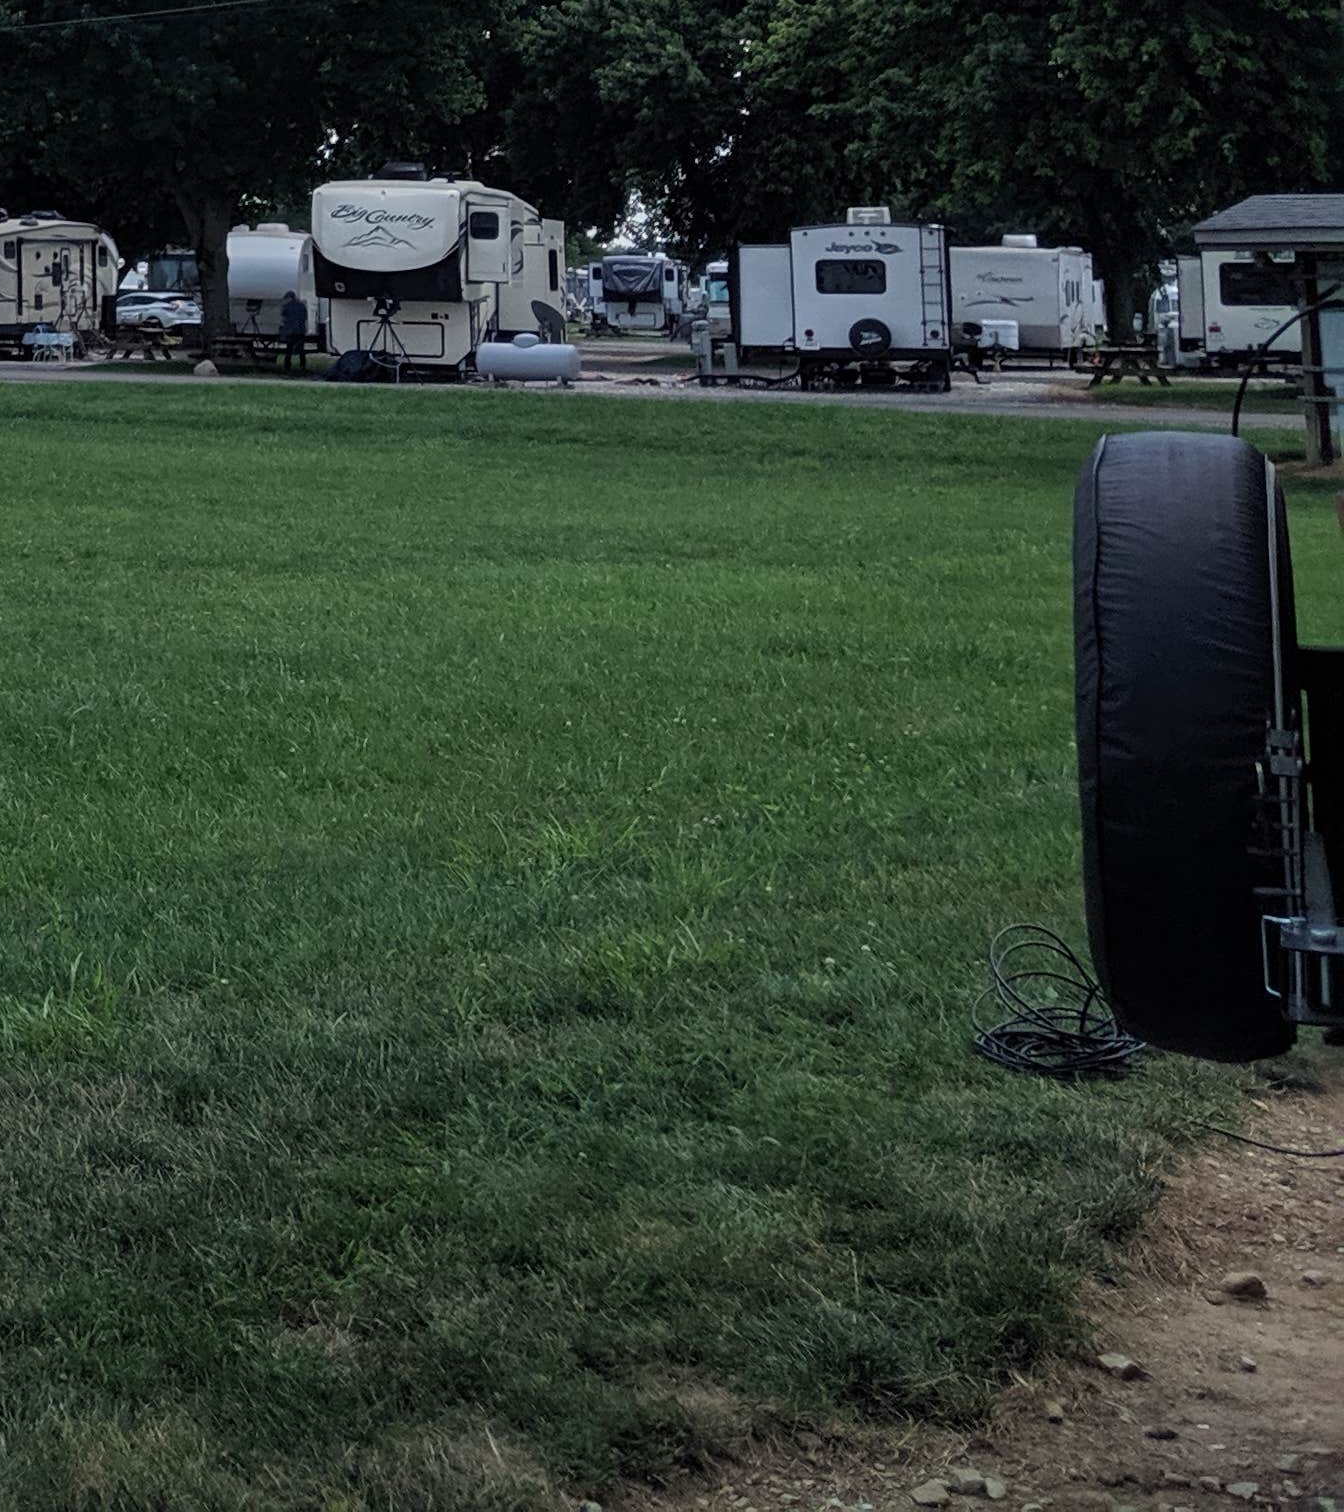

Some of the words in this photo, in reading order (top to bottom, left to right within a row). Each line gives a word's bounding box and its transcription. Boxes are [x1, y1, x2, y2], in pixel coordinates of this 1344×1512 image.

[330, 204, 368, 224] Big
[365, 209, 435, 230] Country
[825, 242, 873, 254] Jayco
